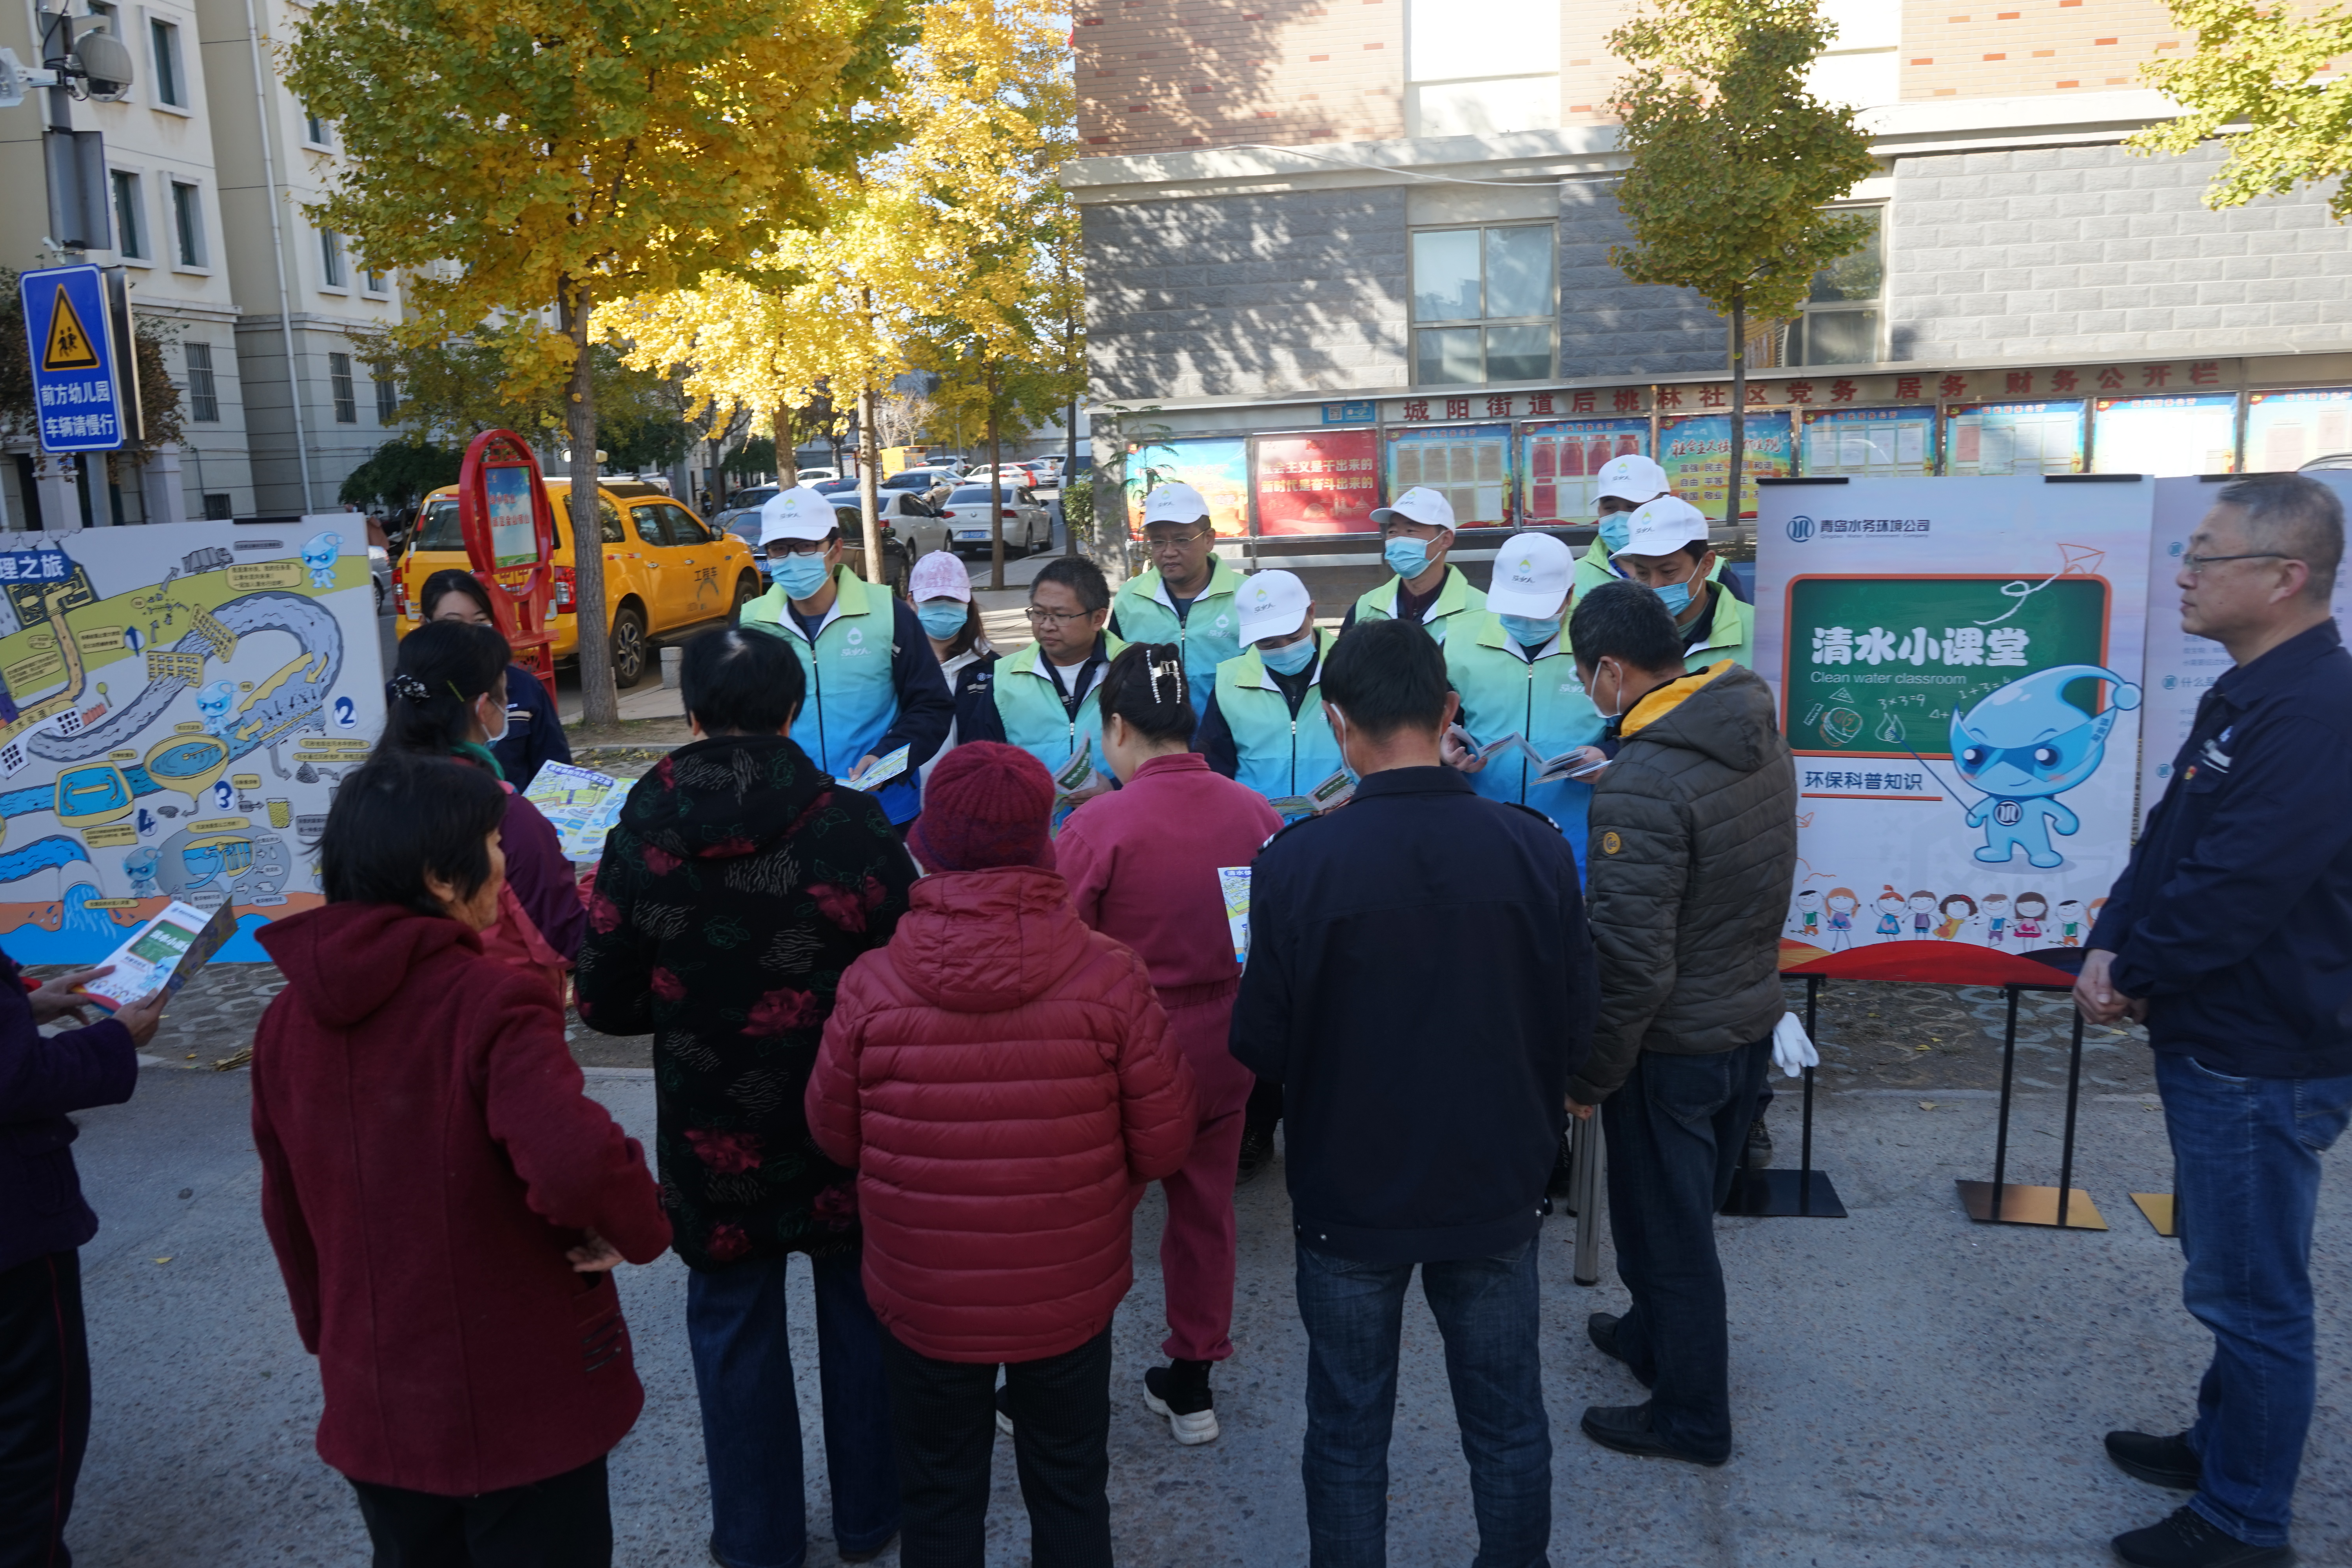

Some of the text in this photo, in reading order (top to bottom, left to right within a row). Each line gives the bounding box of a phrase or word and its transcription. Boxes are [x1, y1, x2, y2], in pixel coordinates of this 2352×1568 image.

[40, 381, 111, 406] 前方幼儿园
[45, 414, 114, 438] 车辆请慢行
[1672, 436, 1782, 459] 社会主义核价值观
[1261, 458, 1372, 475] 社会主义是干出来的
[1680, 464, 1699, 473] 富强
[1705, 463, 1723, 472] 民主
[1261, 476, 1373, 493] 新时代是奋斗出来的
[1680, 478, 1699, 487] 自由
[1704, 477, 1723, 486] 平等
[1679, 492, 1699, 501] 爱国
[1704, 491, 1723, 500] 敬业
[1820, 520, 1930, 532] 青岛水务环境公司
[694, 567, 718, 581] 工程车
[1811, 626, 2030, 666] 清水小课堂
[1810, 671, 1967, 684] Clean water classroom
[334, 697, 355, 724] 2
[1805, 771, 1923, 790] 环保科普知识
[214, 780, 233, 808] 3
